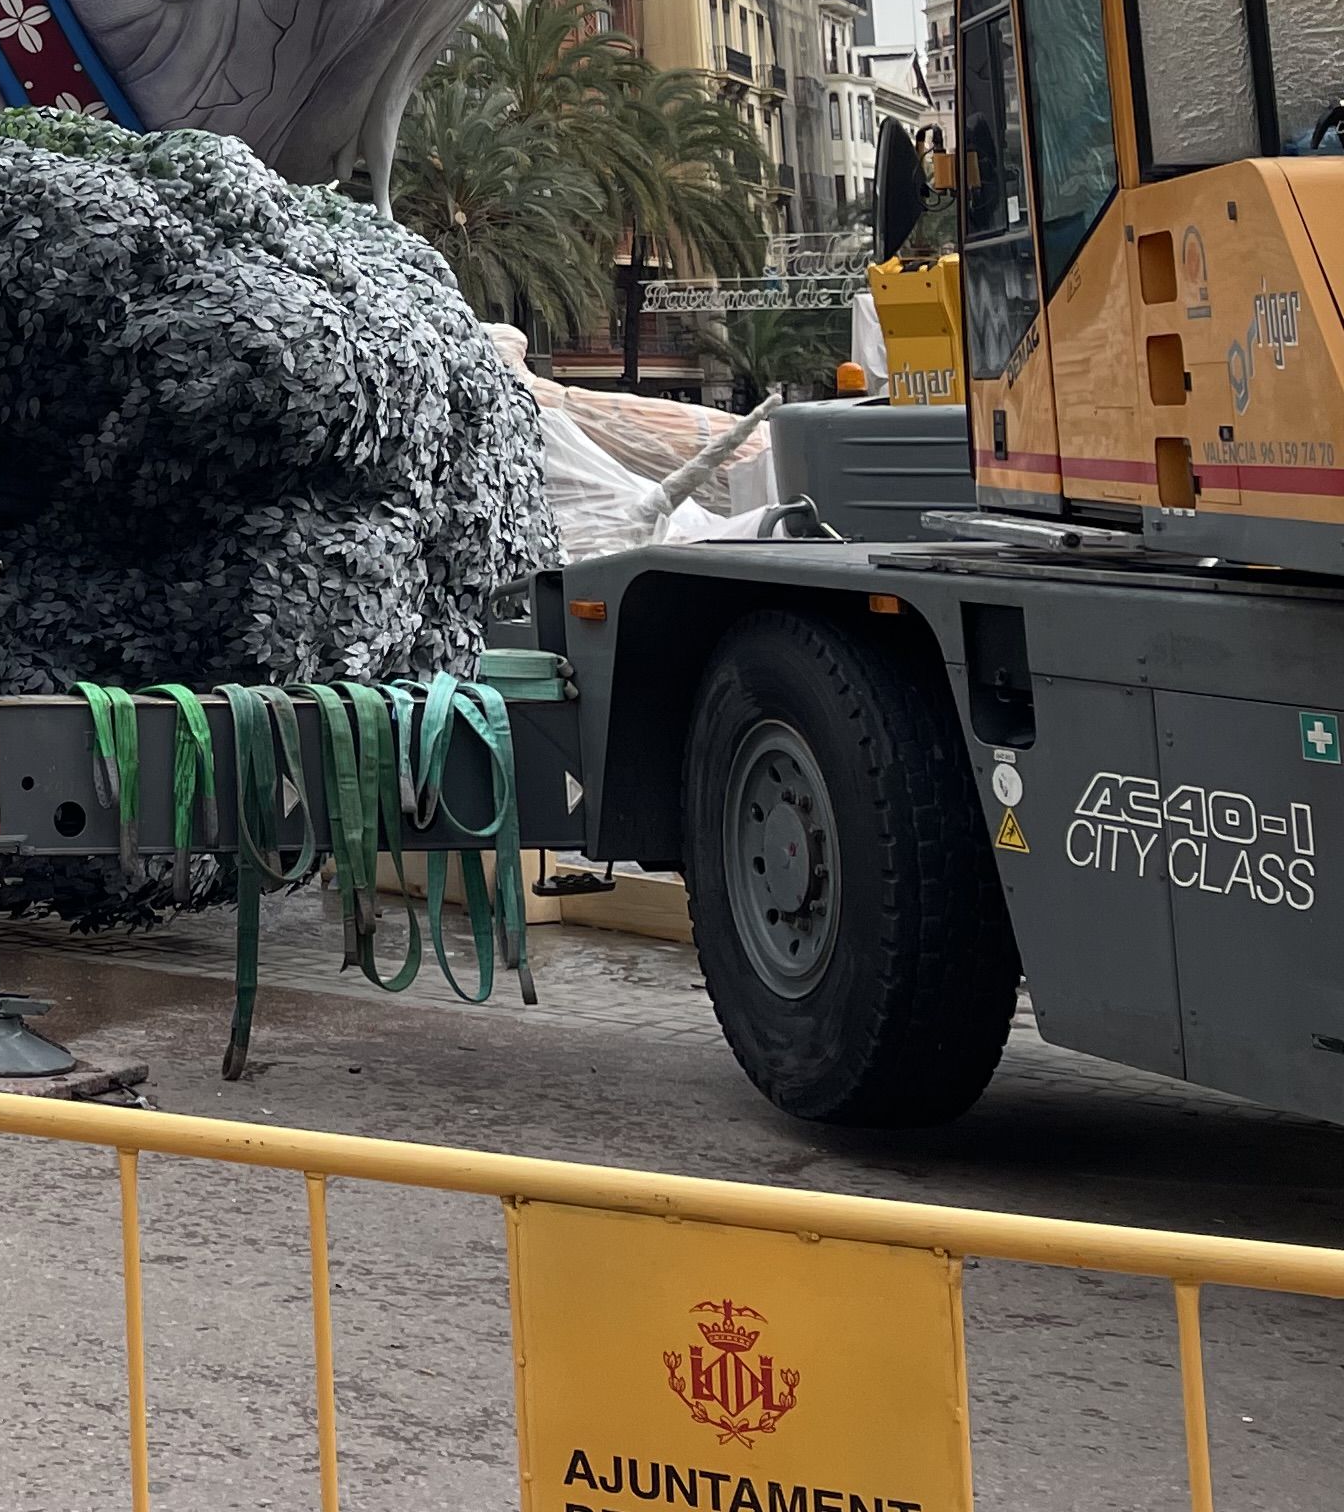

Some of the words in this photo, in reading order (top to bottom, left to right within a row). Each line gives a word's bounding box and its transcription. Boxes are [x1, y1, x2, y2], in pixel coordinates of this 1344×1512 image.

[1254, 276, 1301, 370] rigar
[892, 361, 955, 406] rigar
[1066, 819, 1159, 877] CITY
[1168, 837, 1315, 910] CLASS
